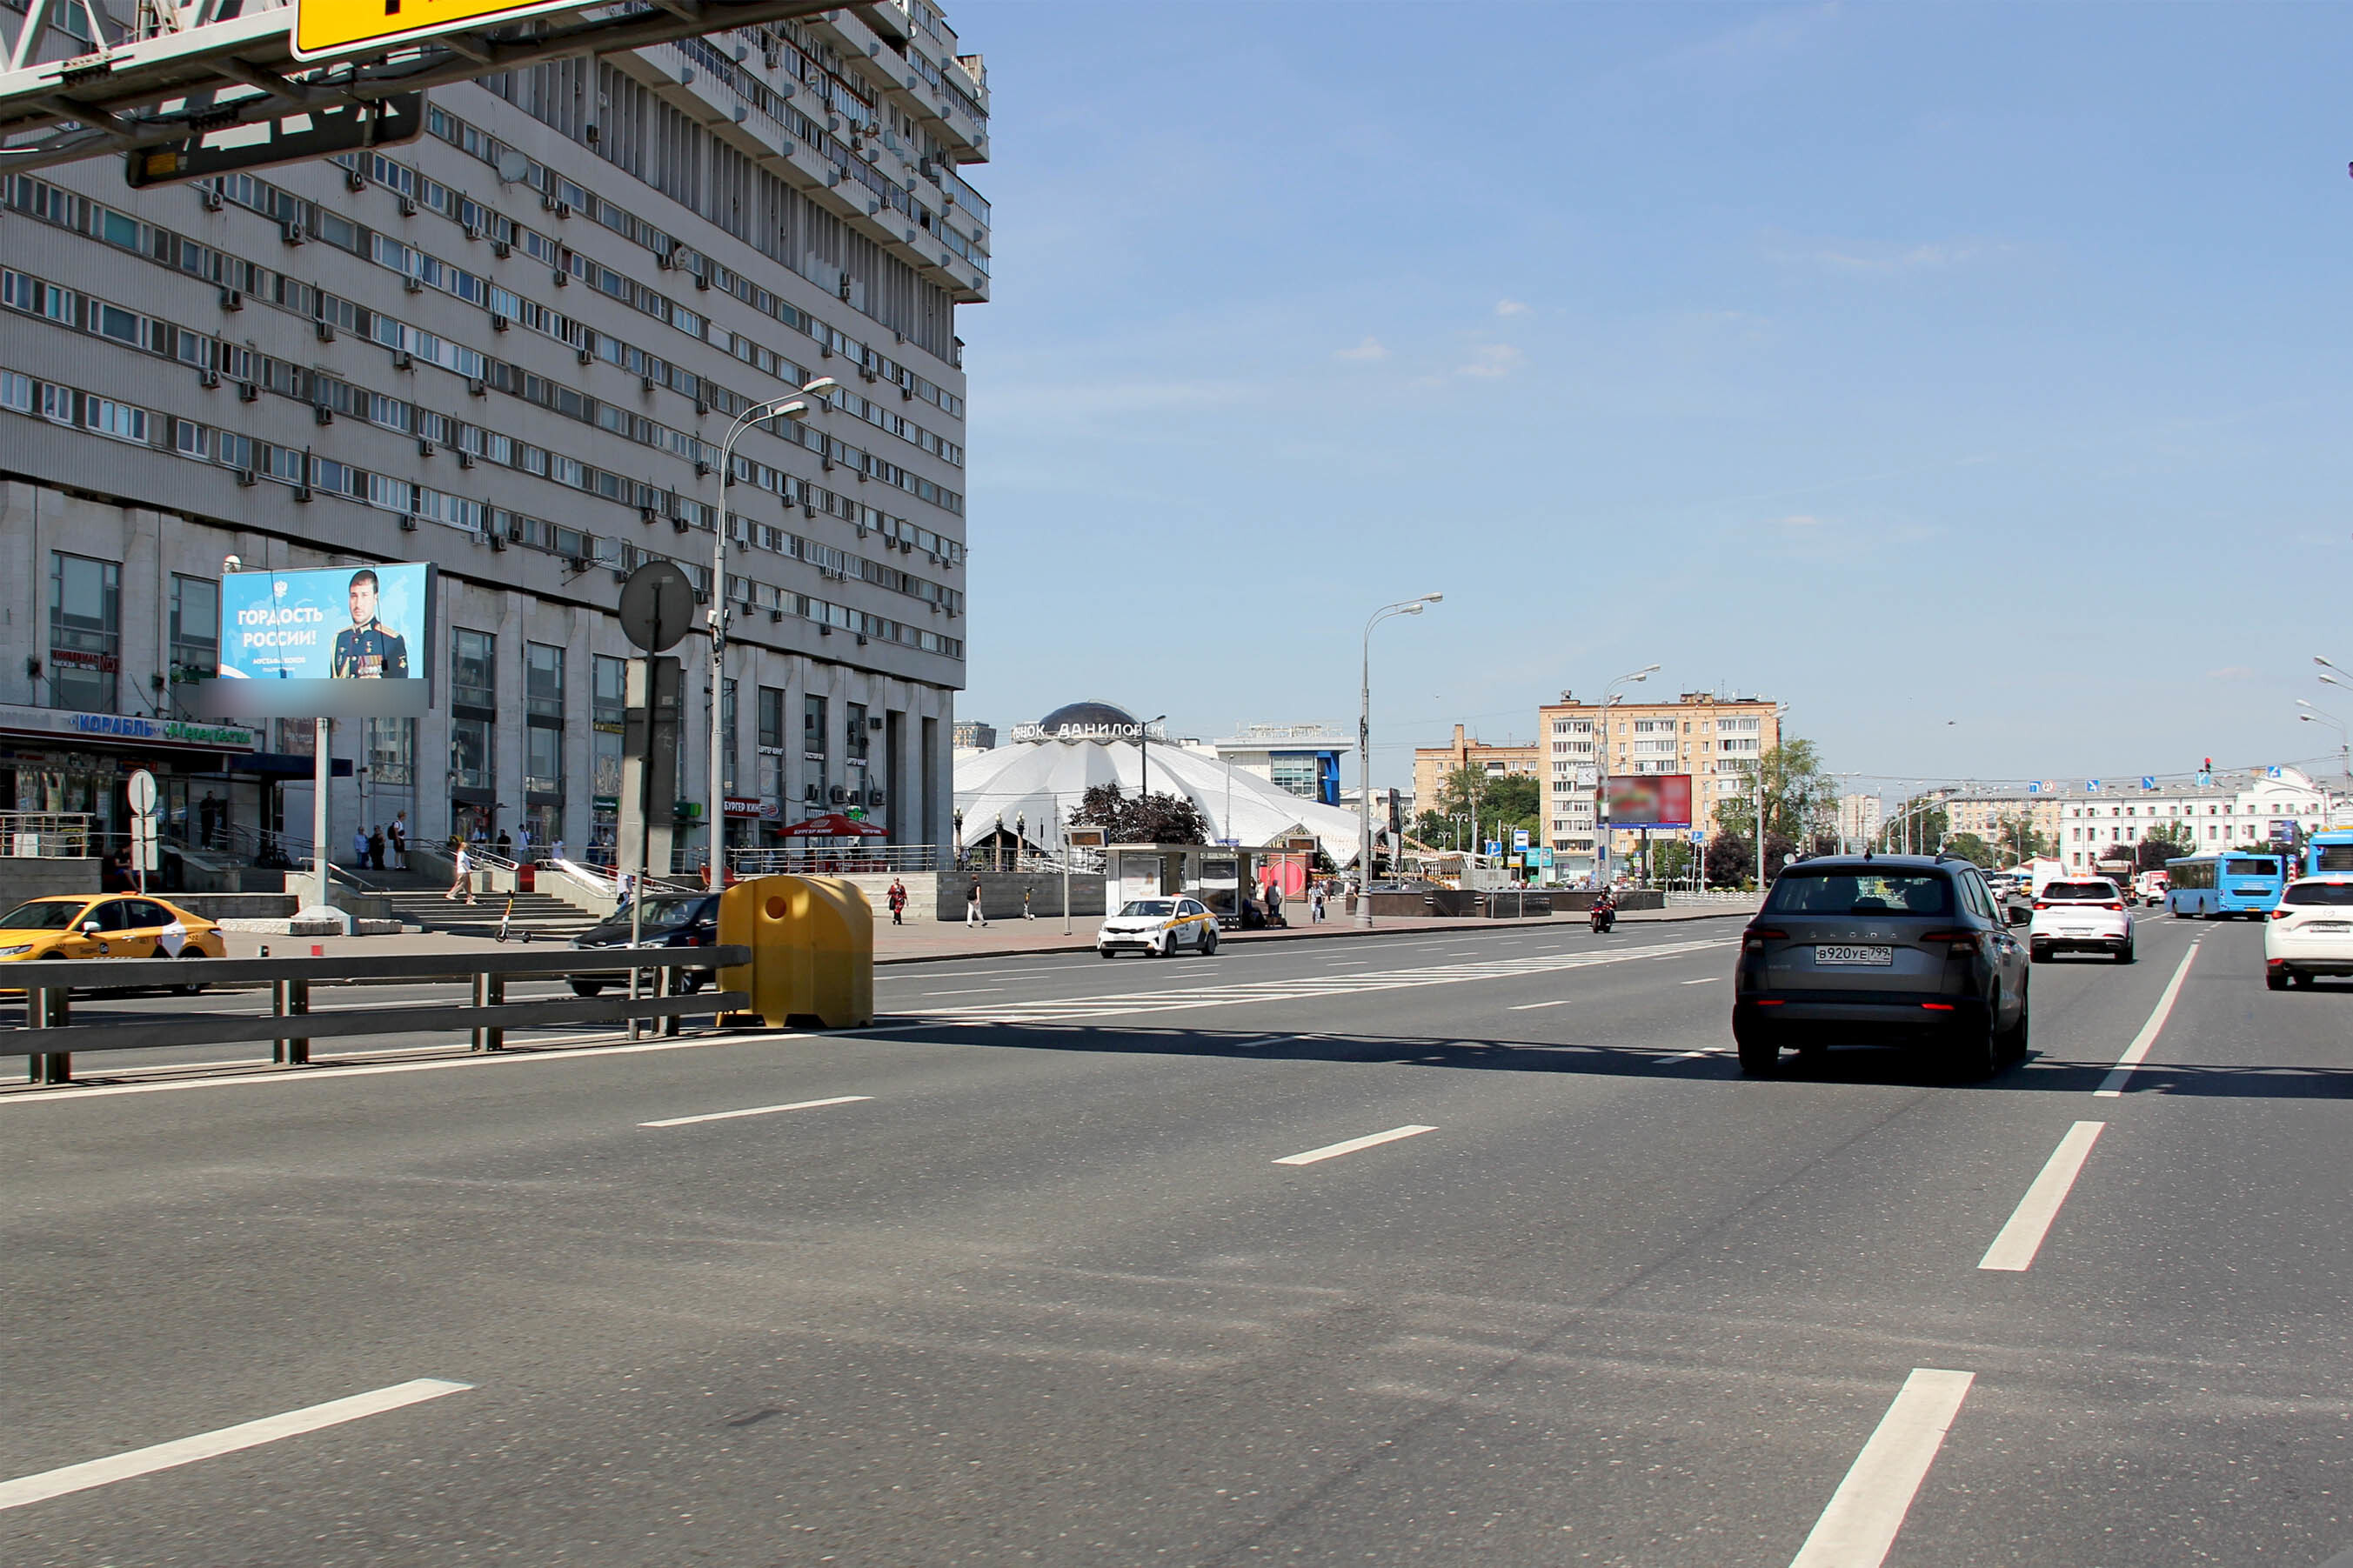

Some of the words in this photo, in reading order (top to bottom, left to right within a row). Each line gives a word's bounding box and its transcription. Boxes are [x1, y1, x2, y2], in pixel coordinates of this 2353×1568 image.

[237, 607, 324, 626] ГОРДОСТЬ
[243, 630, 318, 648] РОССИИ!
[77, 714, 153, 737] КОРАБЛЬ
[724, 801, 745, 812] БУРГЕР
[1869, 947, 1888, 957] 799
